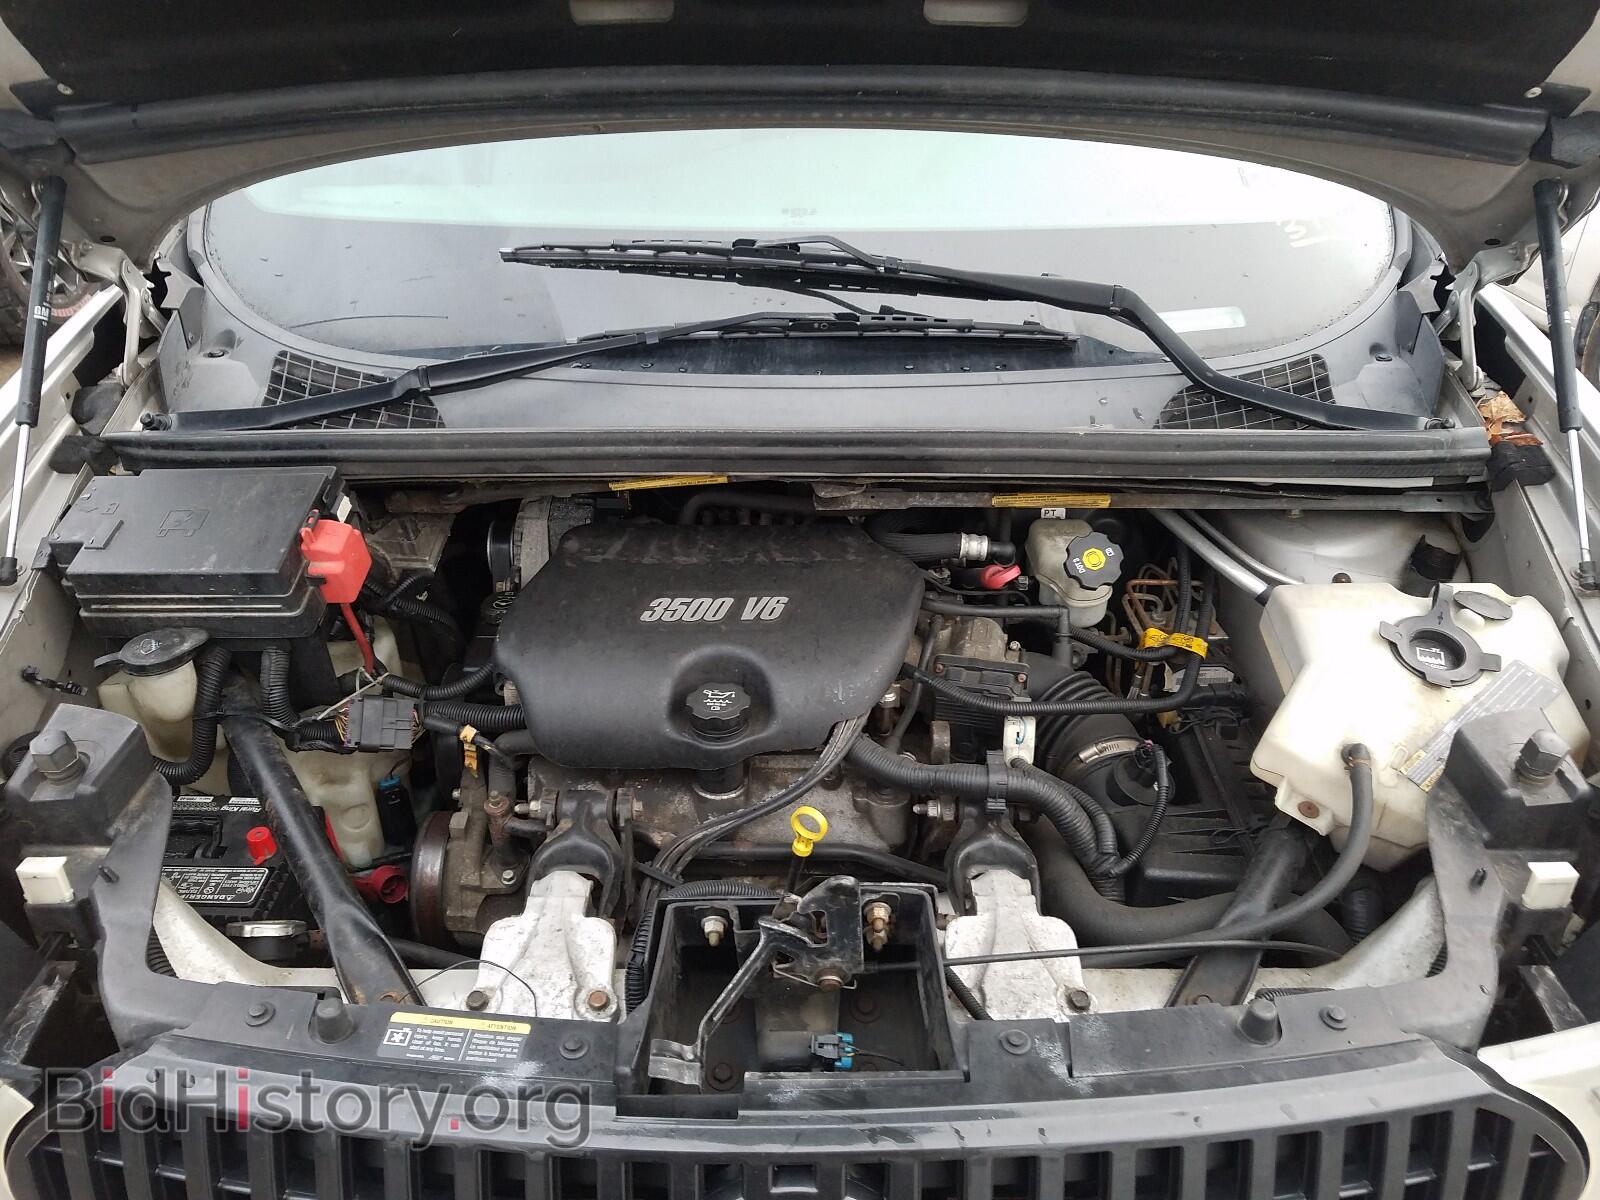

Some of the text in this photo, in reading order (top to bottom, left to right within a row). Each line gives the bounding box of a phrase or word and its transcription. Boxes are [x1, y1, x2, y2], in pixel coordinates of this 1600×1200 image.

[34, 305, 49, 317] GM
[639, 595, 790, 622] 3500 V6
